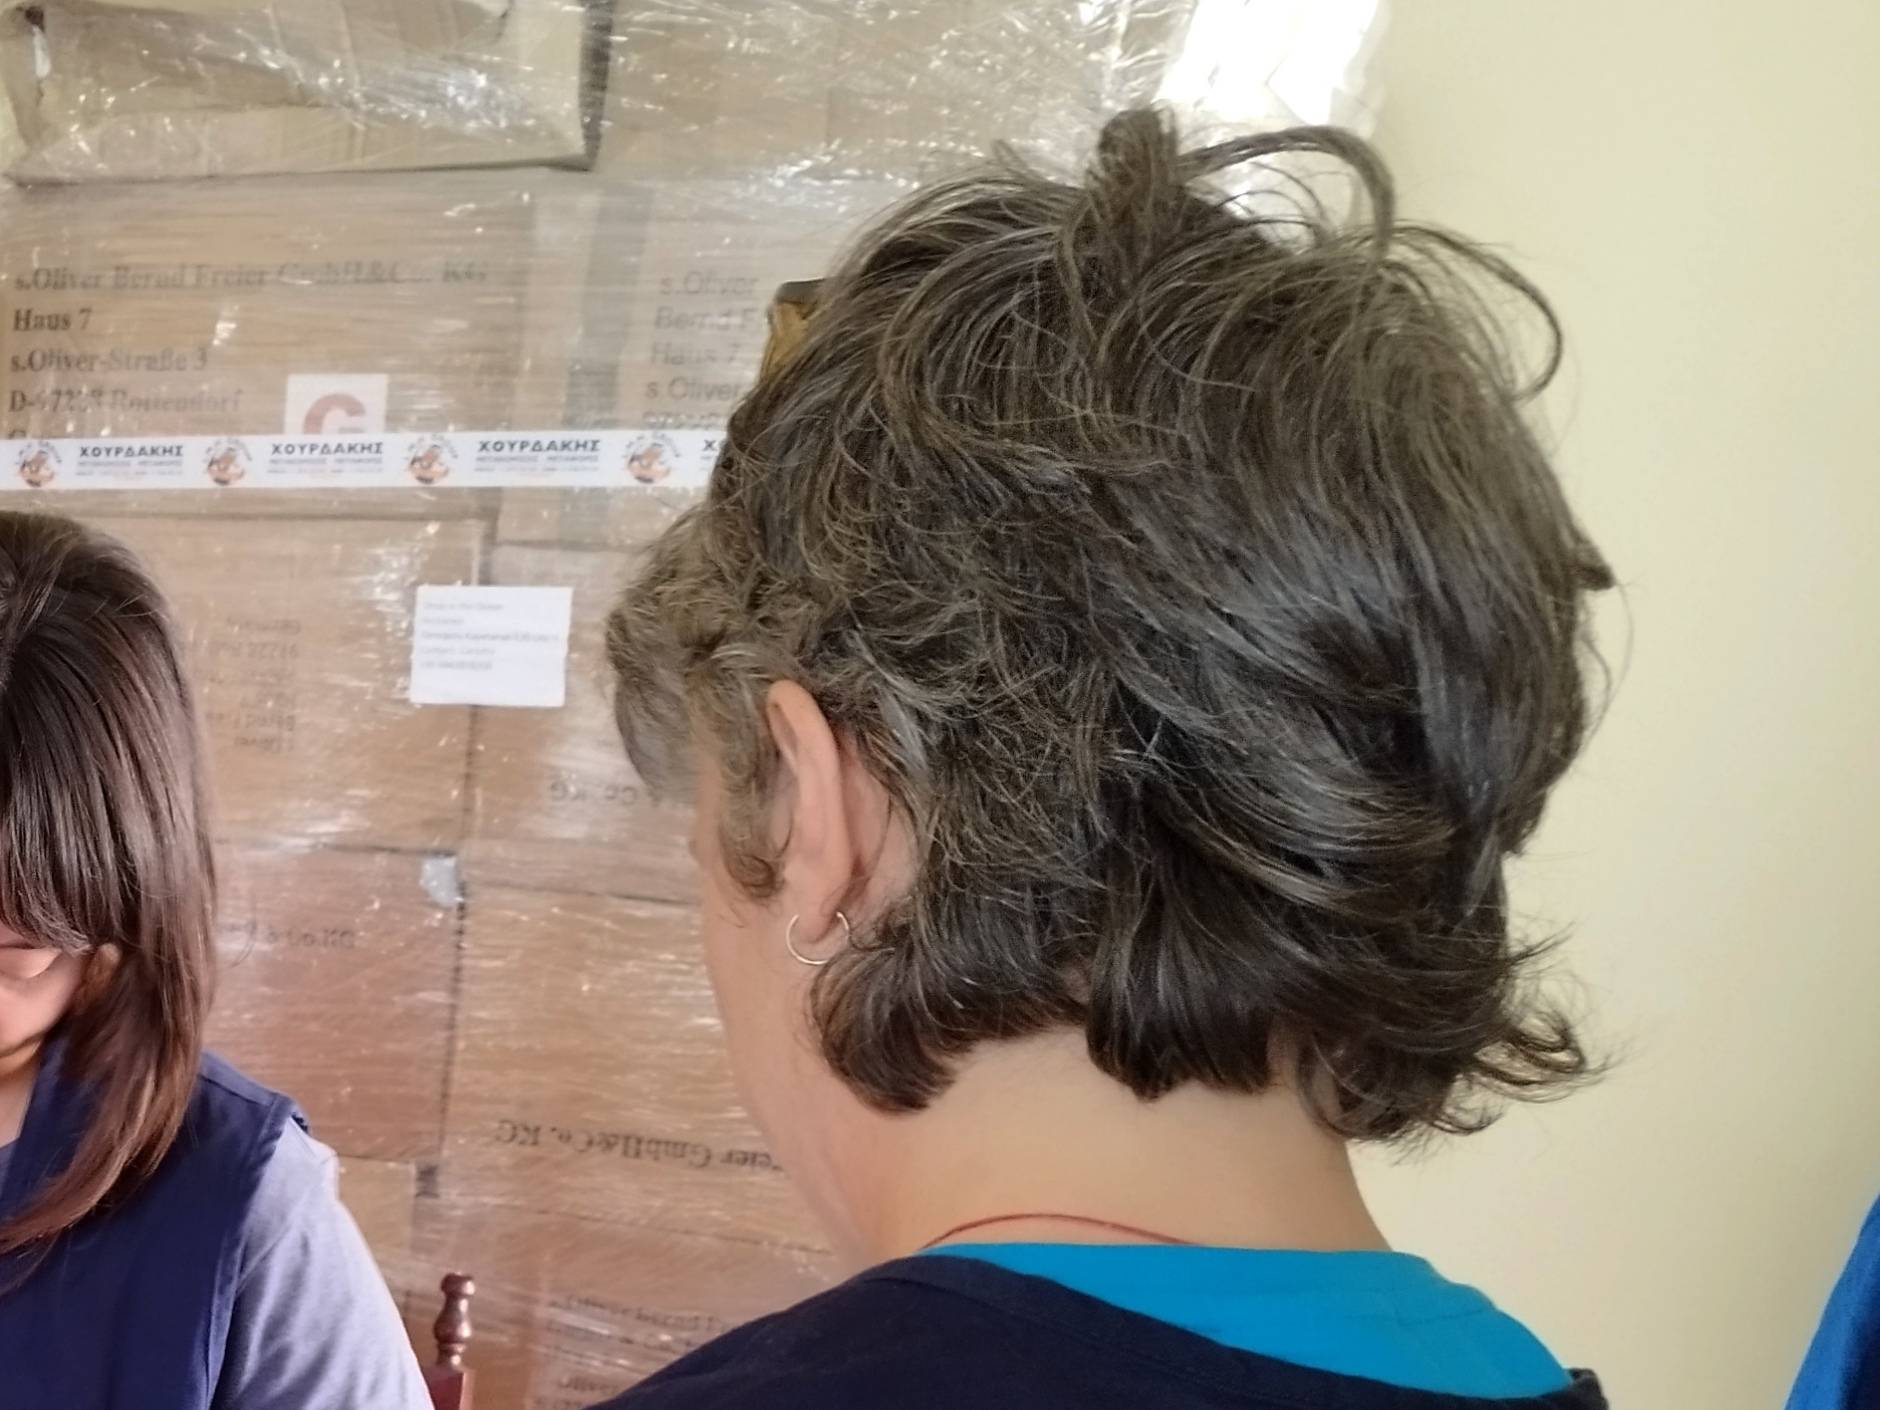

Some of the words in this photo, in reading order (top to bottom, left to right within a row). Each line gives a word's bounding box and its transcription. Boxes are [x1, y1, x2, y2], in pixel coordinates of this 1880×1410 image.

[13, 308, 71, 332] Haus
[78, 308, 93, 331] 7
[79, 445, 184, 458] ΧΟΥΡΔΑΚΗΣ
[271, 441, 384, 455] ΧΟΥΡΔΑΚΗΣ
[477, 439, 602, 452] ΧΟΥΡΔΑΚΗΣ
